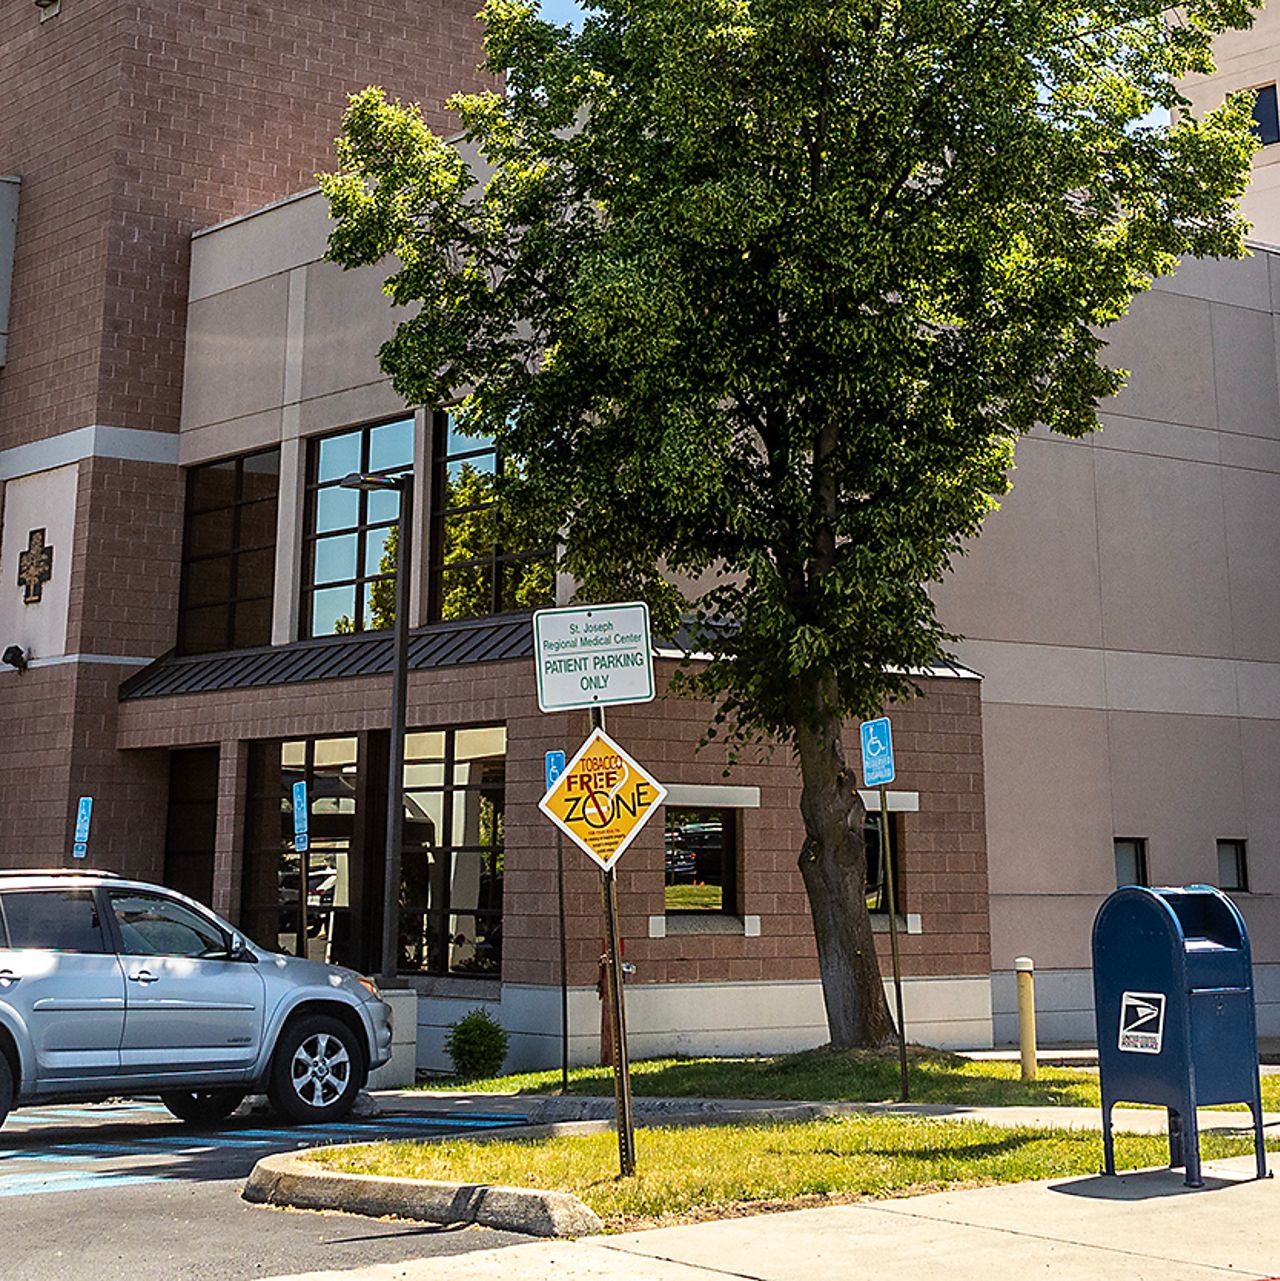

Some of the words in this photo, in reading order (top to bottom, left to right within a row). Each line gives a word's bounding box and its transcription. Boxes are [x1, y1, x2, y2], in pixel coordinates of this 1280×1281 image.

[569, 623, 580, 634] St.
[583, 621, 614, 633] Joseph
[543, 638, 577, 651] Regional
[580, 635, 612, 647] Medical
[613, 633, 642, 644] Center
[544, 657, 589, 674] PATIENT
[593, 652, 644, 670] PARKING
[579, 675, 609, 691] ONLY
[580, 755, 623, 772] TOBACCO
[566, 771, 617, 792] FREE
[563, 782, 652, 829] ZONE
